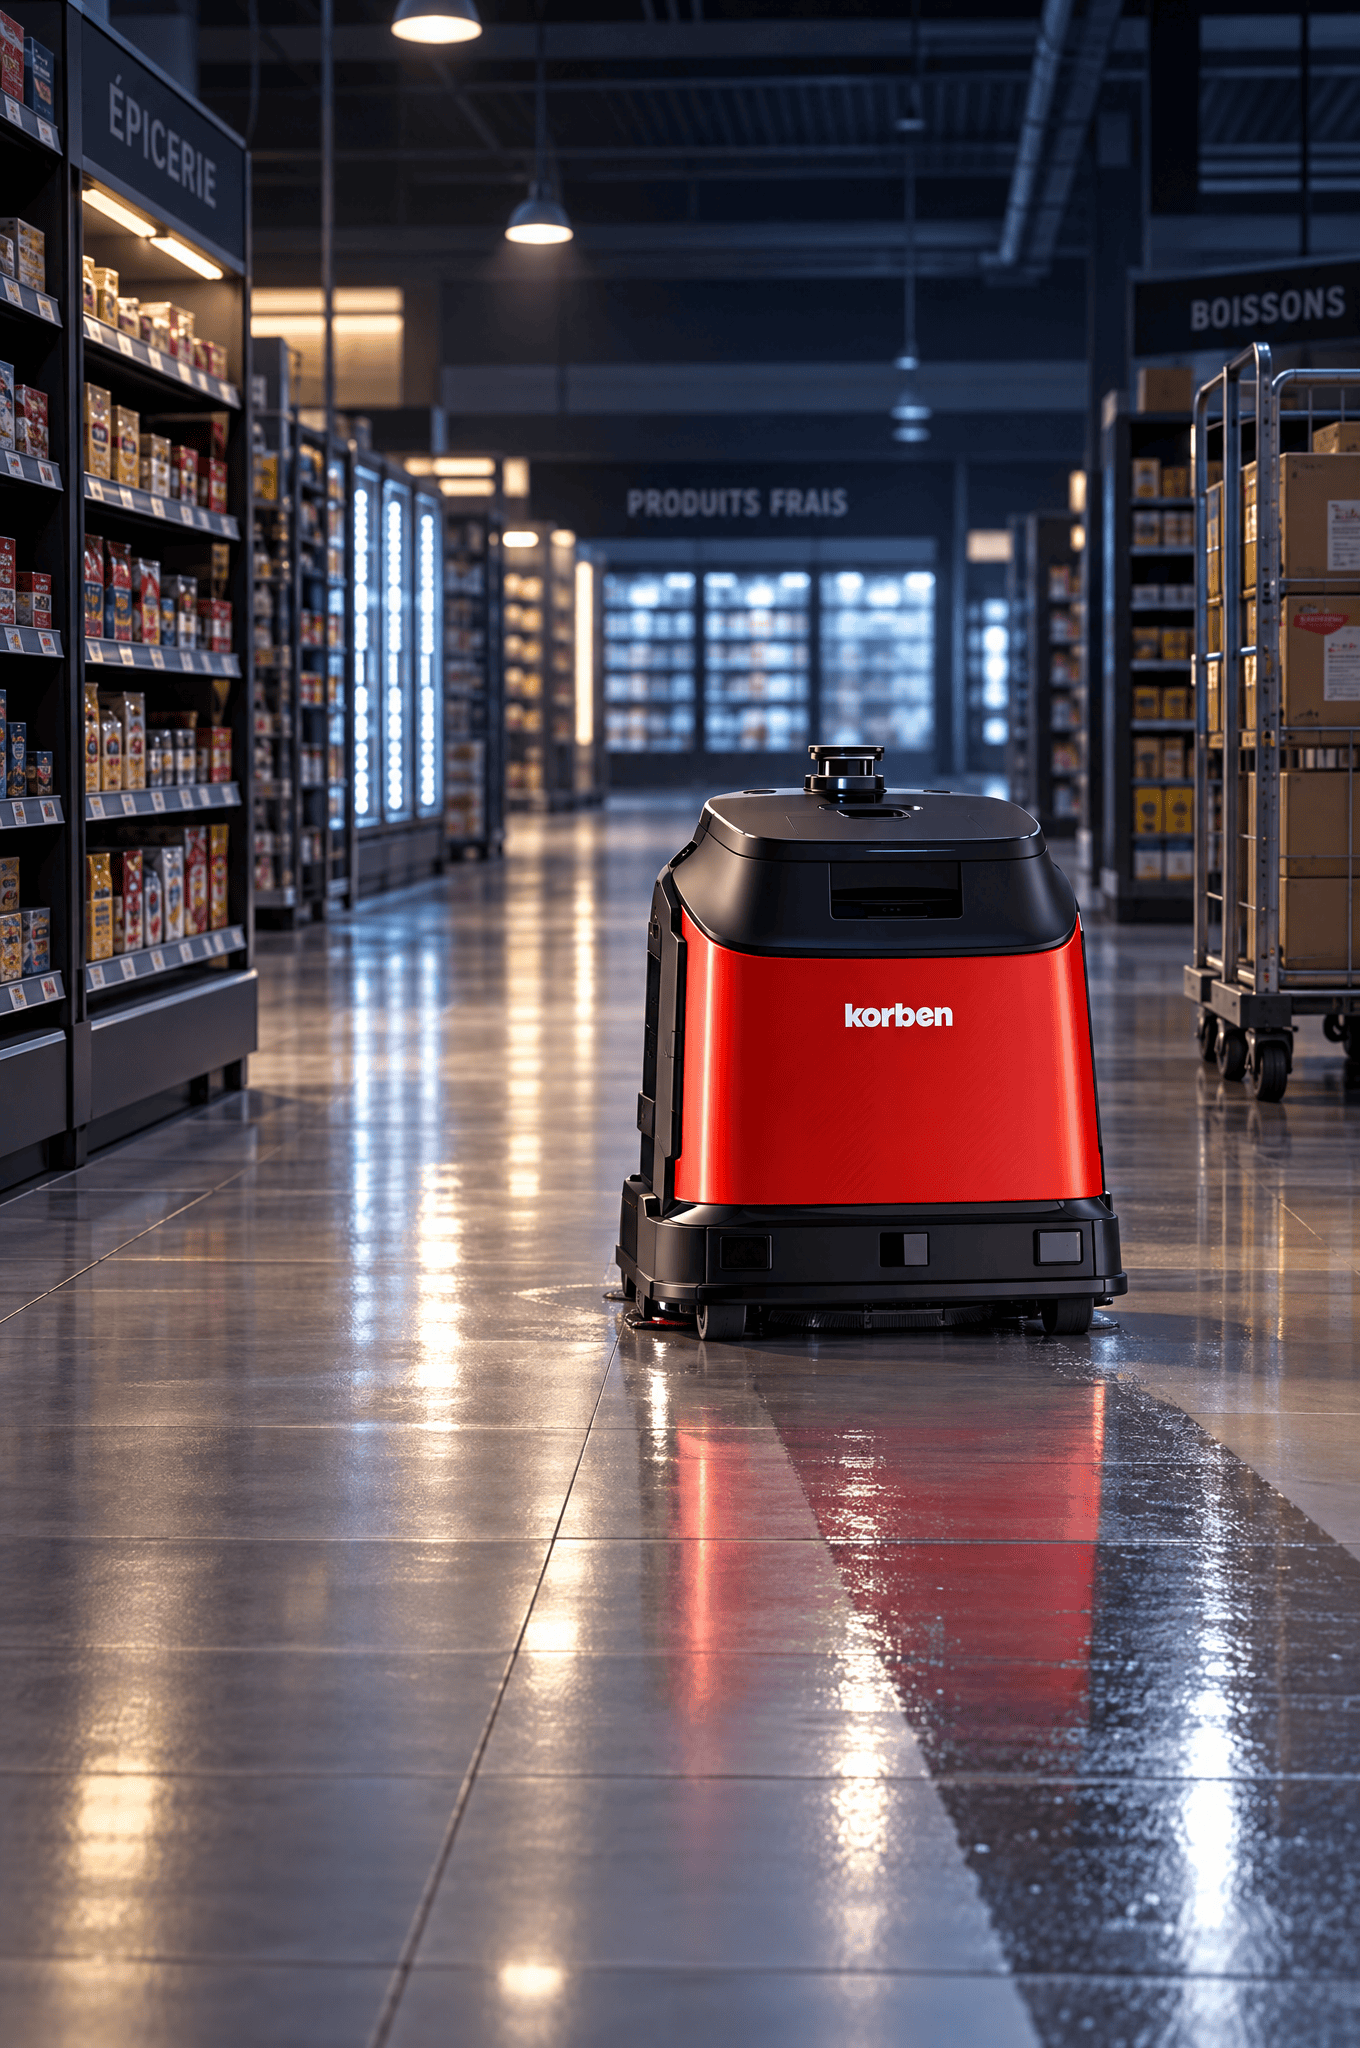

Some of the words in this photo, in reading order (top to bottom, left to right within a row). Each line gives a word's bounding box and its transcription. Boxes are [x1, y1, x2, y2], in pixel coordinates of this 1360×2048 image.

[108, 75, 217, 209] ÉPICERIE
[1191, 285, 1345, 331] BOISSONS
[627, 488, 761, 517] PRODUITS
[769, 488, 848, 517] FRAIS
[844, 1002, 953, 1028] korben
